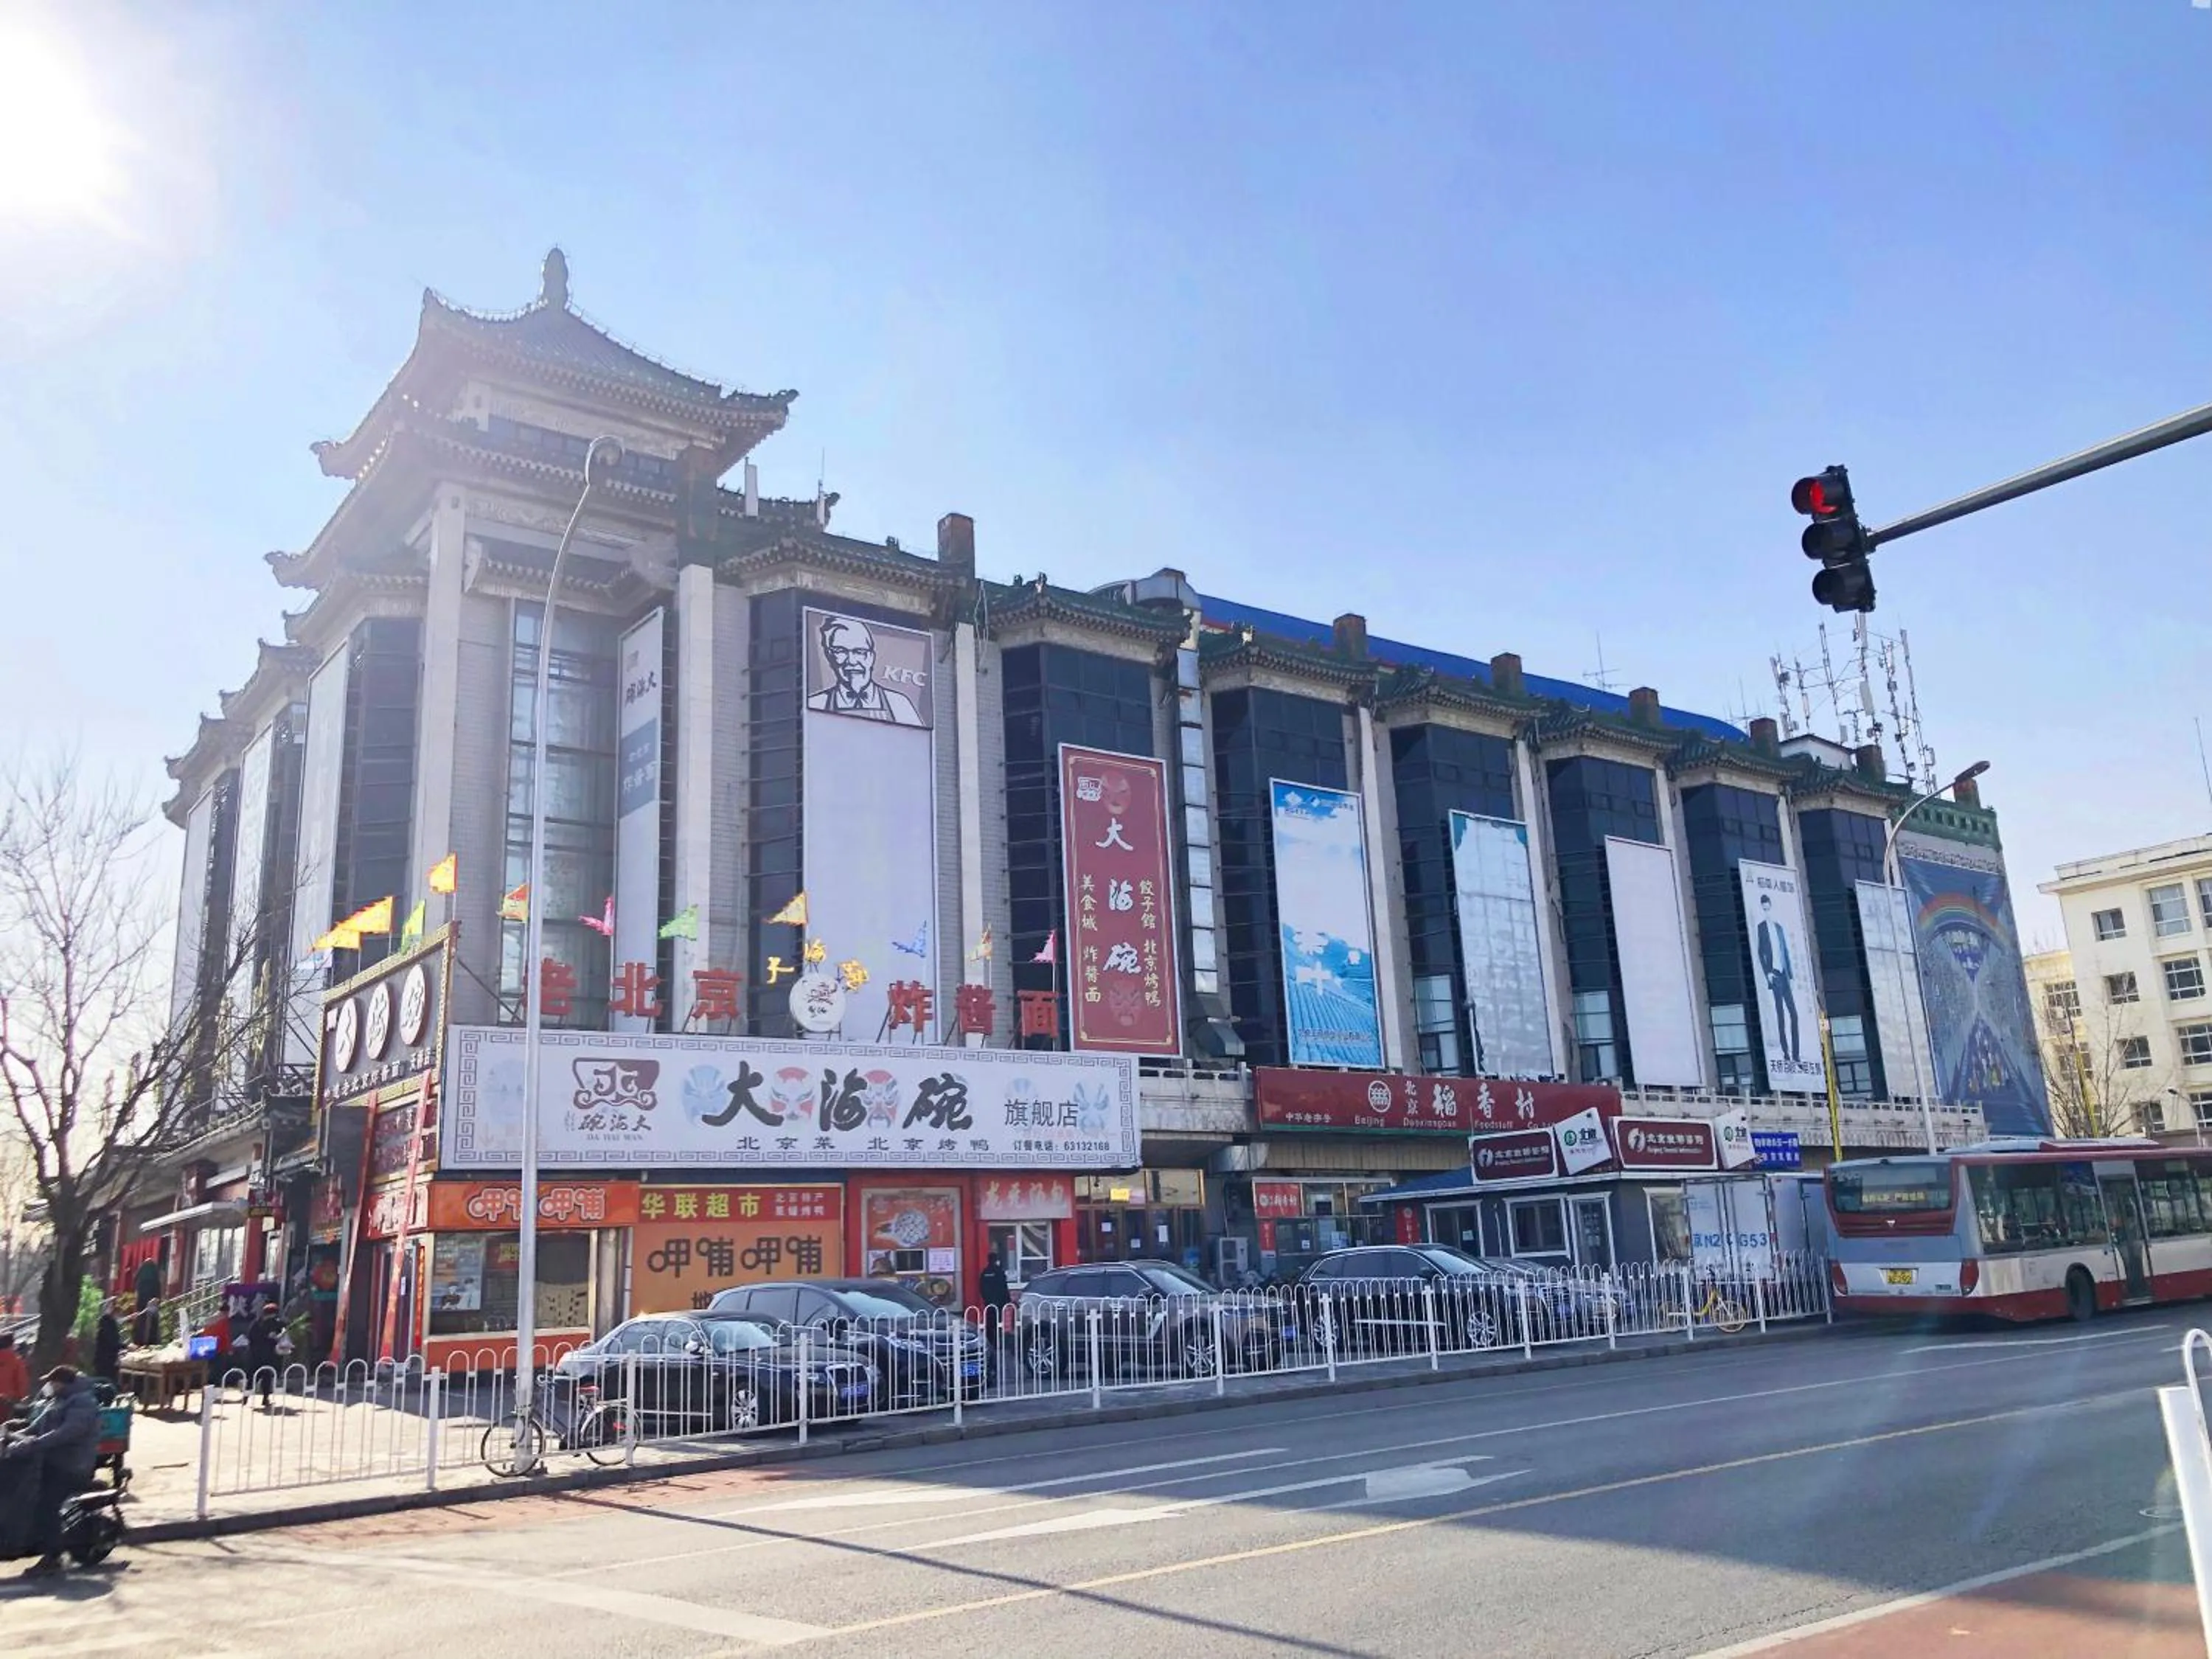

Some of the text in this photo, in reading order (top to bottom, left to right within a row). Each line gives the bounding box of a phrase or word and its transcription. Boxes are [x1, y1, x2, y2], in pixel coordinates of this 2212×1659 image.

[882, 665, 928, 686] KFC
[1096, 818, 1141, 974] 大海碗
[701, 1060, 973, 1132] 大海碗
[1433, 1082, 1535, 1120] 稻香村
[1004, 1098, 1079, 1127] 旗舰店
[1354, 1114, 1385, 1128] Beijing
[867, 1135, 990, 1152] 北京烤鸭
[641, 1192, 762, 1219] 华联超市
[647, 1234, 822, 1279] 呷哺呷哺
